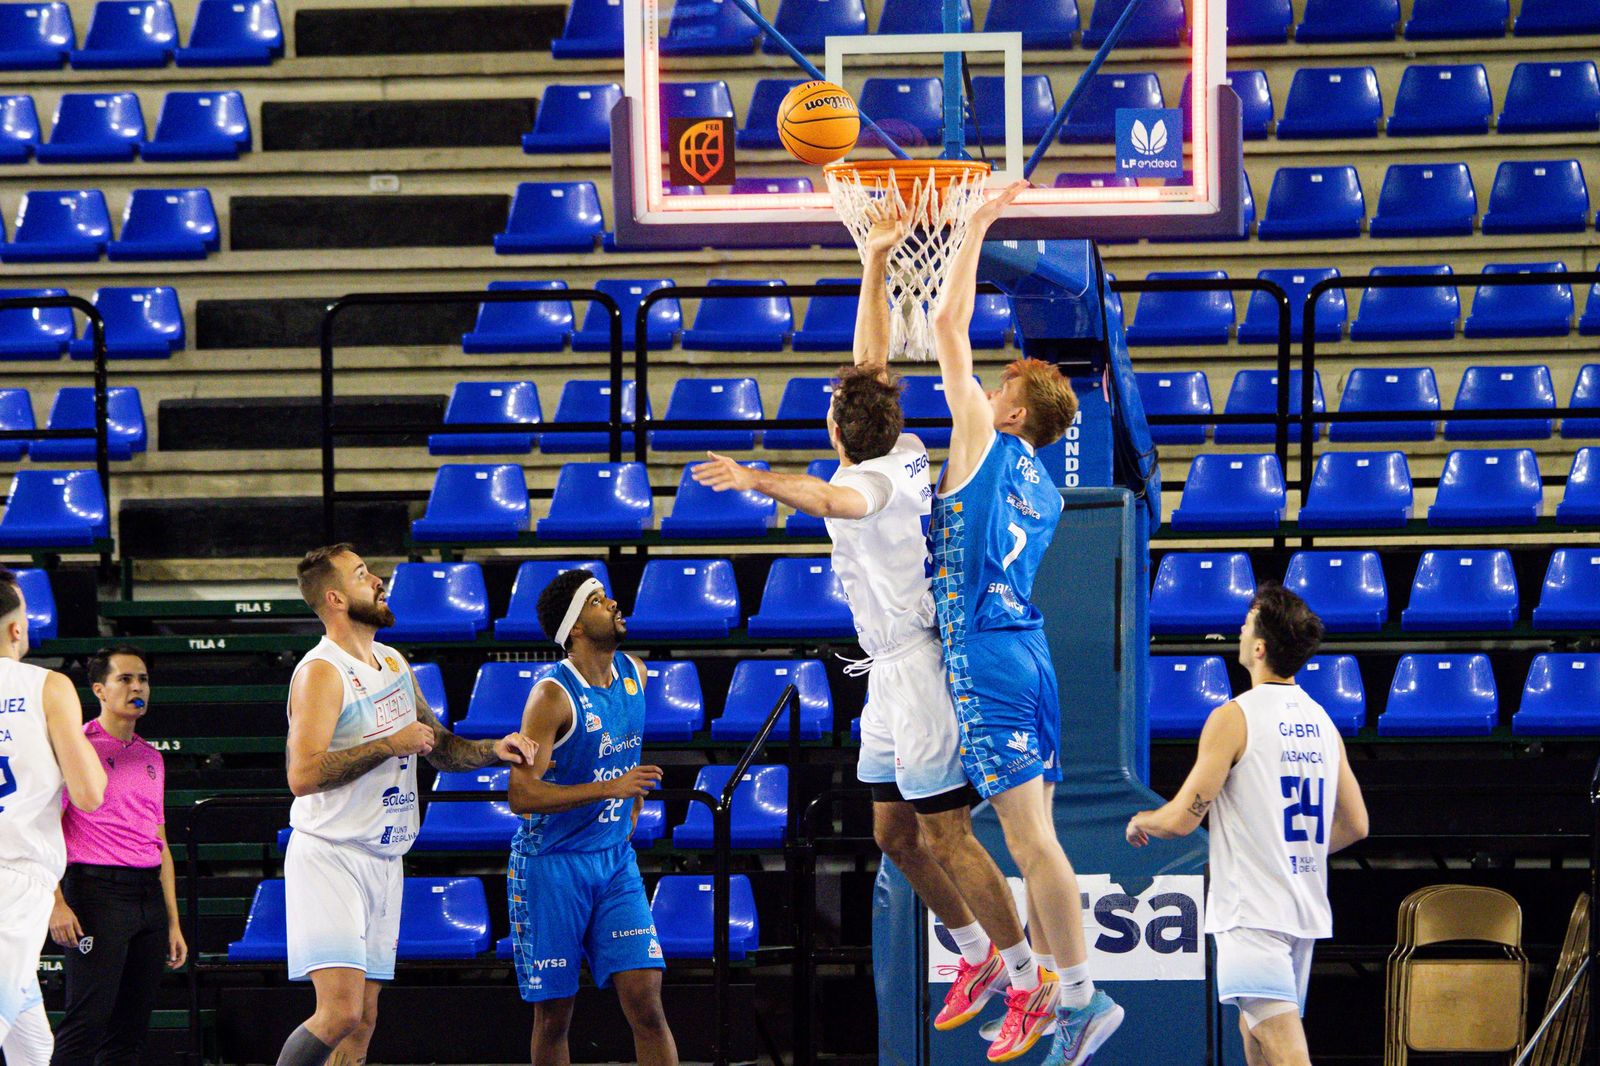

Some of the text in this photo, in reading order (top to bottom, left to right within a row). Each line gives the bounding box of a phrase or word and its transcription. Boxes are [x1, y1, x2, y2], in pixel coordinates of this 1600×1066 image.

[804, 95, 855, 111] Wilson
[1121, 158, 1177, 168] LF endesa
[1002, 521, 1027, 572] 7
[235, 603, 271, 612] FILA 5
[217, 639, 225, 648] 4
[1279, 722, 1320, 738] GABRI
[172, 740, 180, 750] 3
[1280, 776, 1324, 844] 24
[612, 928, 651, 938] E.Leclerc
